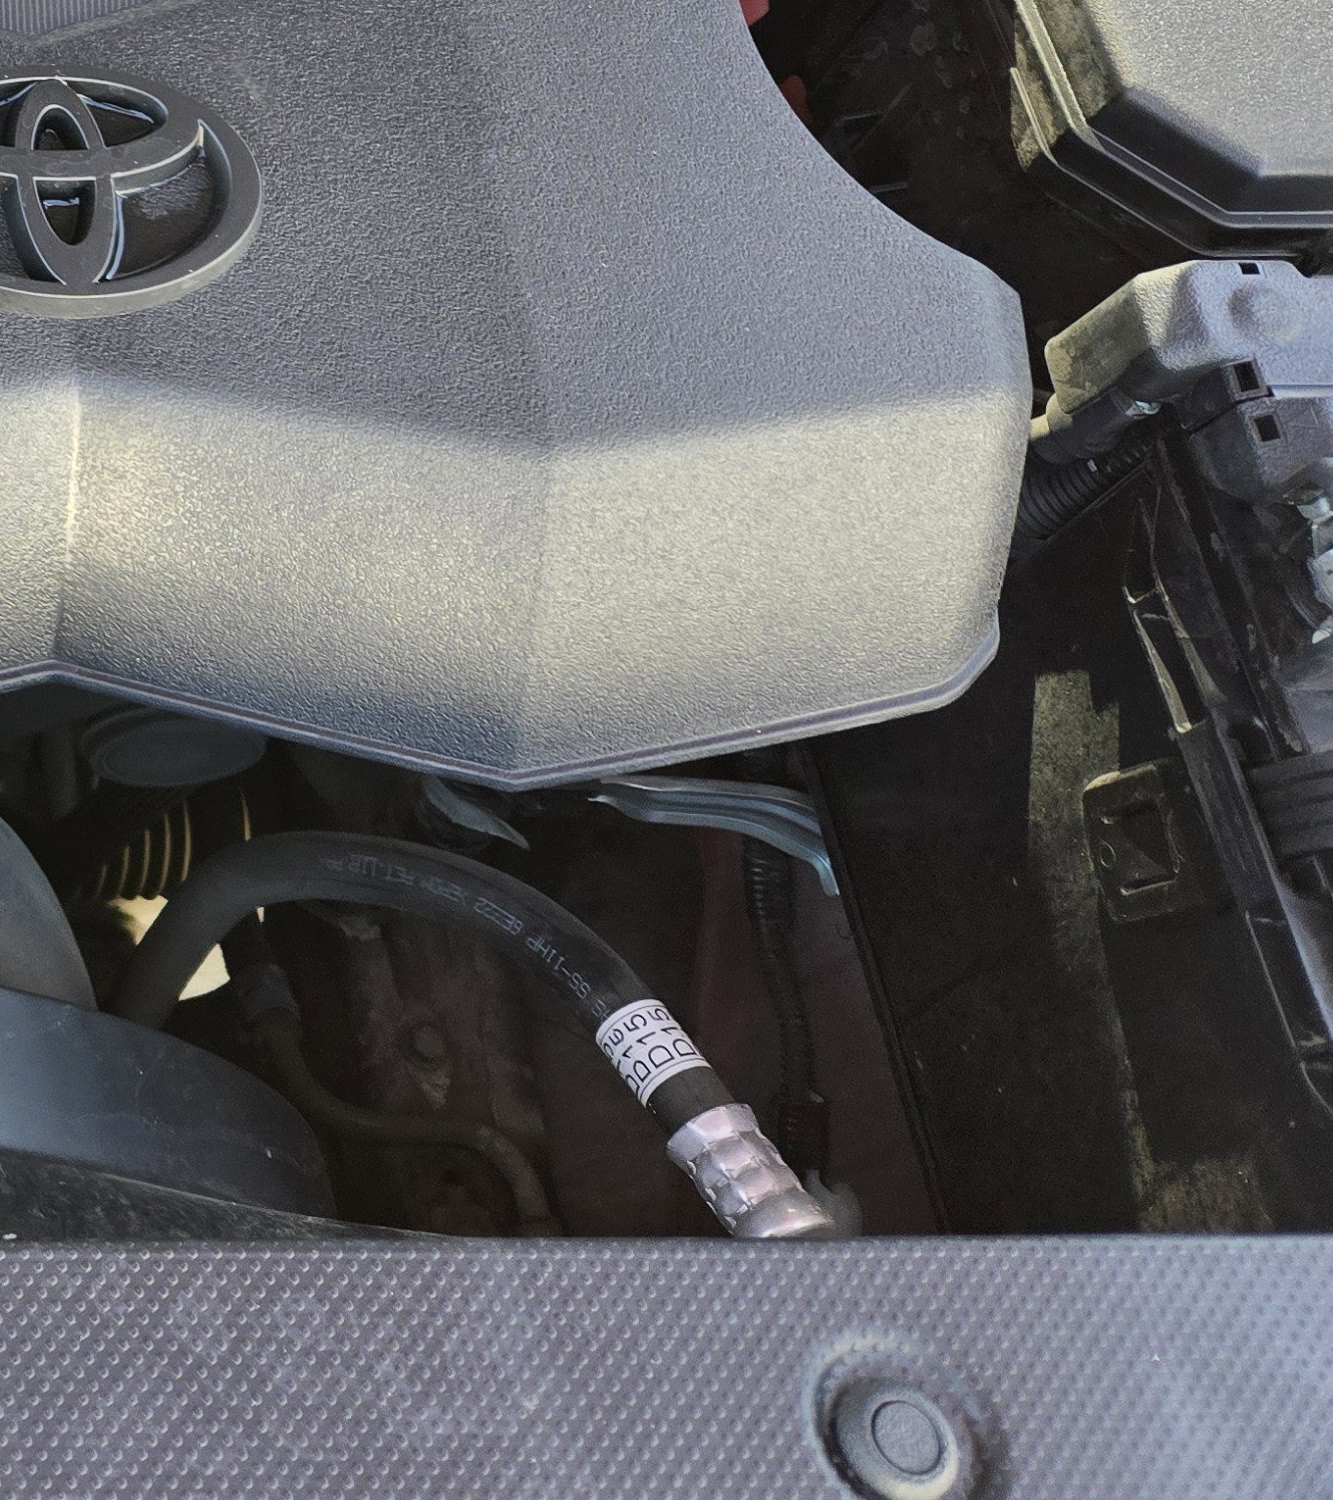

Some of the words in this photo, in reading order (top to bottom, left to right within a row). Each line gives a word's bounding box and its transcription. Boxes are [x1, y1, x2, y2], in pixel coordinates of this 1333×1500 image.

[608, 1026, 650, 1083] D15
[622, 1011, 675, 1069] D15
[647, 1006, 697, 1056] D15
